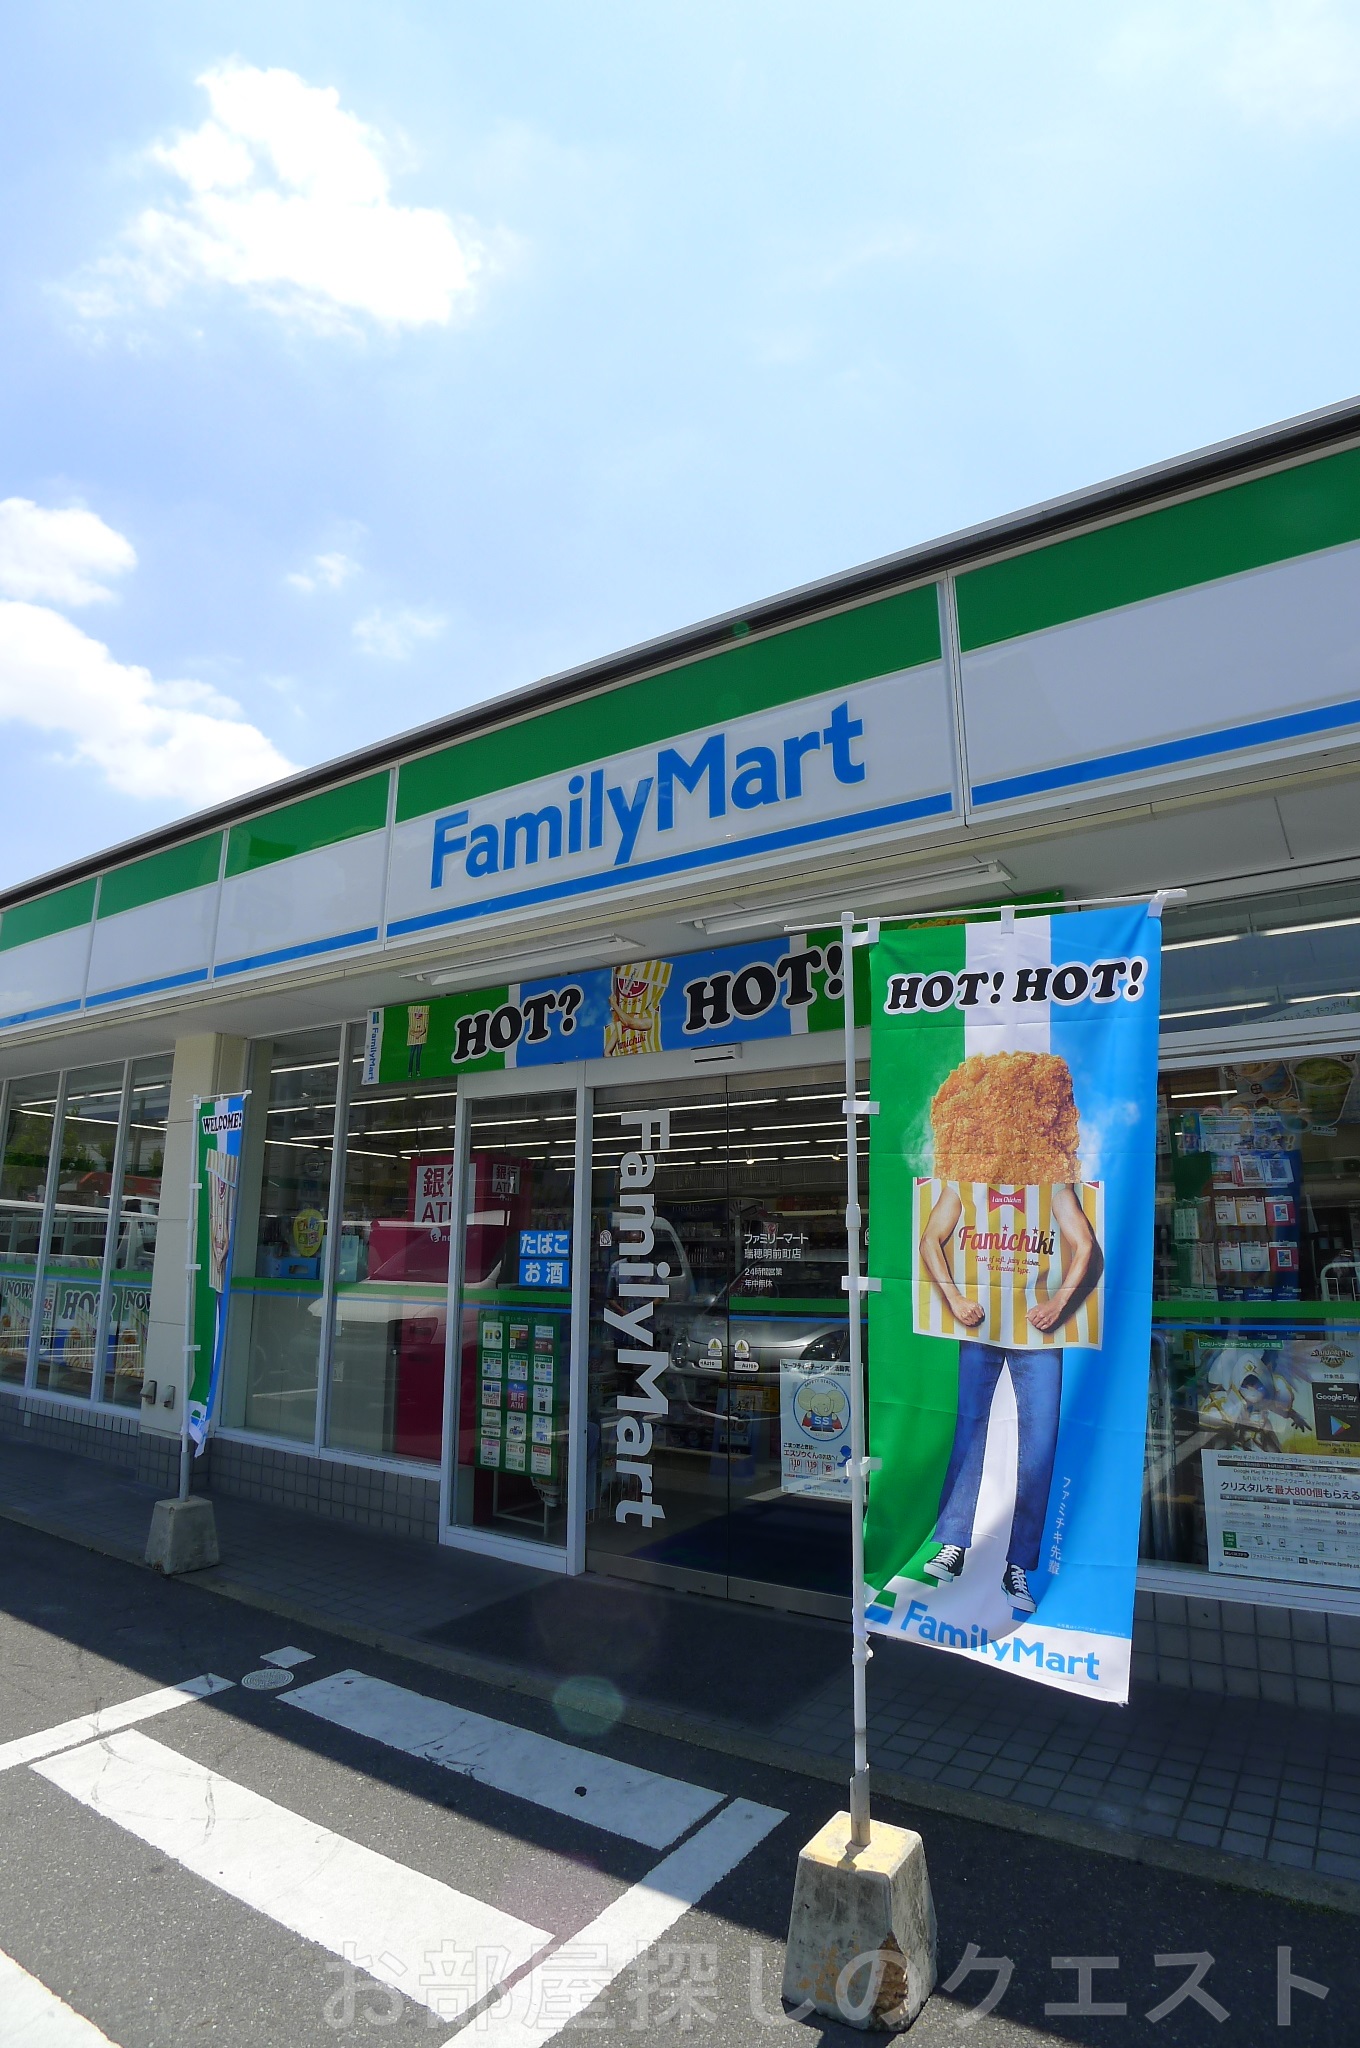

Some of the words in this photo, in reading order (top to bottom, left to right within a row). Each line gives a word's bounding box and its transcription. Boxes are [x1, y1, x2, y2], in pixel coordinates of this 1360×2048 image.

[430, 700, 866, 890] FamilyMart
[684, 943, 843, 1031] HOT!
[888, 972, 1004, 1010] HOT!
[1012, 961, 1144, 1004] HOT!
[453, 988, 581, 1060] HOT?
[368, 1028, 379, 1080] FamilyMart
[203, 1111, 242, 1133] WELCOME!
[496, 1165, 517, 1180] 銀行
[495, 1181, 516, 1193] ATM
[421, 1202, 452, 1223] AT
[521, 1233, 569, 1254] たばこ
[744, 1233, 809, 1245] ファミリーマート
[958, 1224, 1055, 1256] Famichiki
[744, 1248, 802, 1260] 瑞穂明前町店
[525, 1261, 563, 1284] お酒
[744, 1267, 783, 1276] 24時間営業
[744, 1280, 773, 1288] 年中無休
[602, 1108, 670, 1527] FamilyMart
[1316, 1393, 1342, 1402] Google
[1342, 1393, 1357, 1403] Play
[814, 1416, 830, 1426] SS
[1048, 1476, 1071, 1576] ファミチキ先輩
[900, 1599, 1101, 1681] FamilyMart
